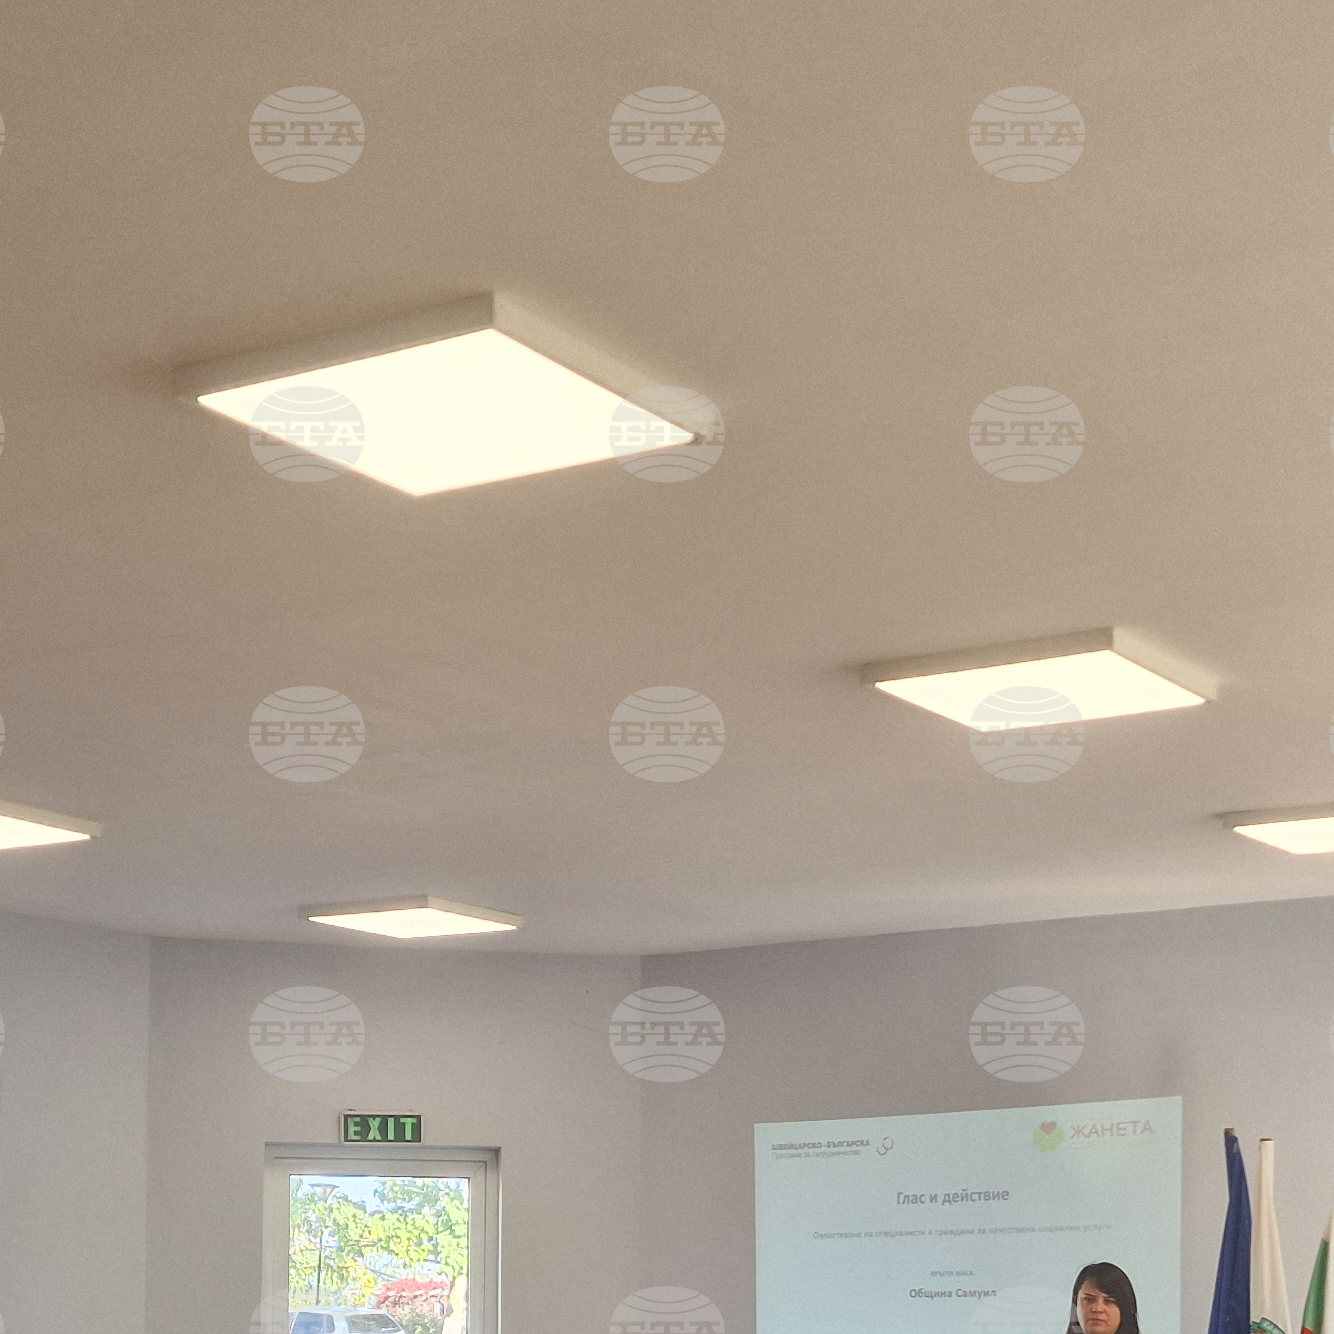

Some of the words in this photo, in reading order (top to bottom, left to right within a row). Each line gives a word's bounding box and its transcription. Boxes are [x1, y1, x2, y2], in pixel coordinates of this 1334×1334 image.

[347, 1117, 417, 1141] EXIT
[1070, 1120, 1154, 1139] ЖАНЕТА
[896, 1191, 926, 1205] Глас
[929, 1192, 938, 1203] и
[941, 1188, 1009, 1206] действие
[909, 1288, 953, 1300] Община
[955, 1288, 997, 1300] Самуил
